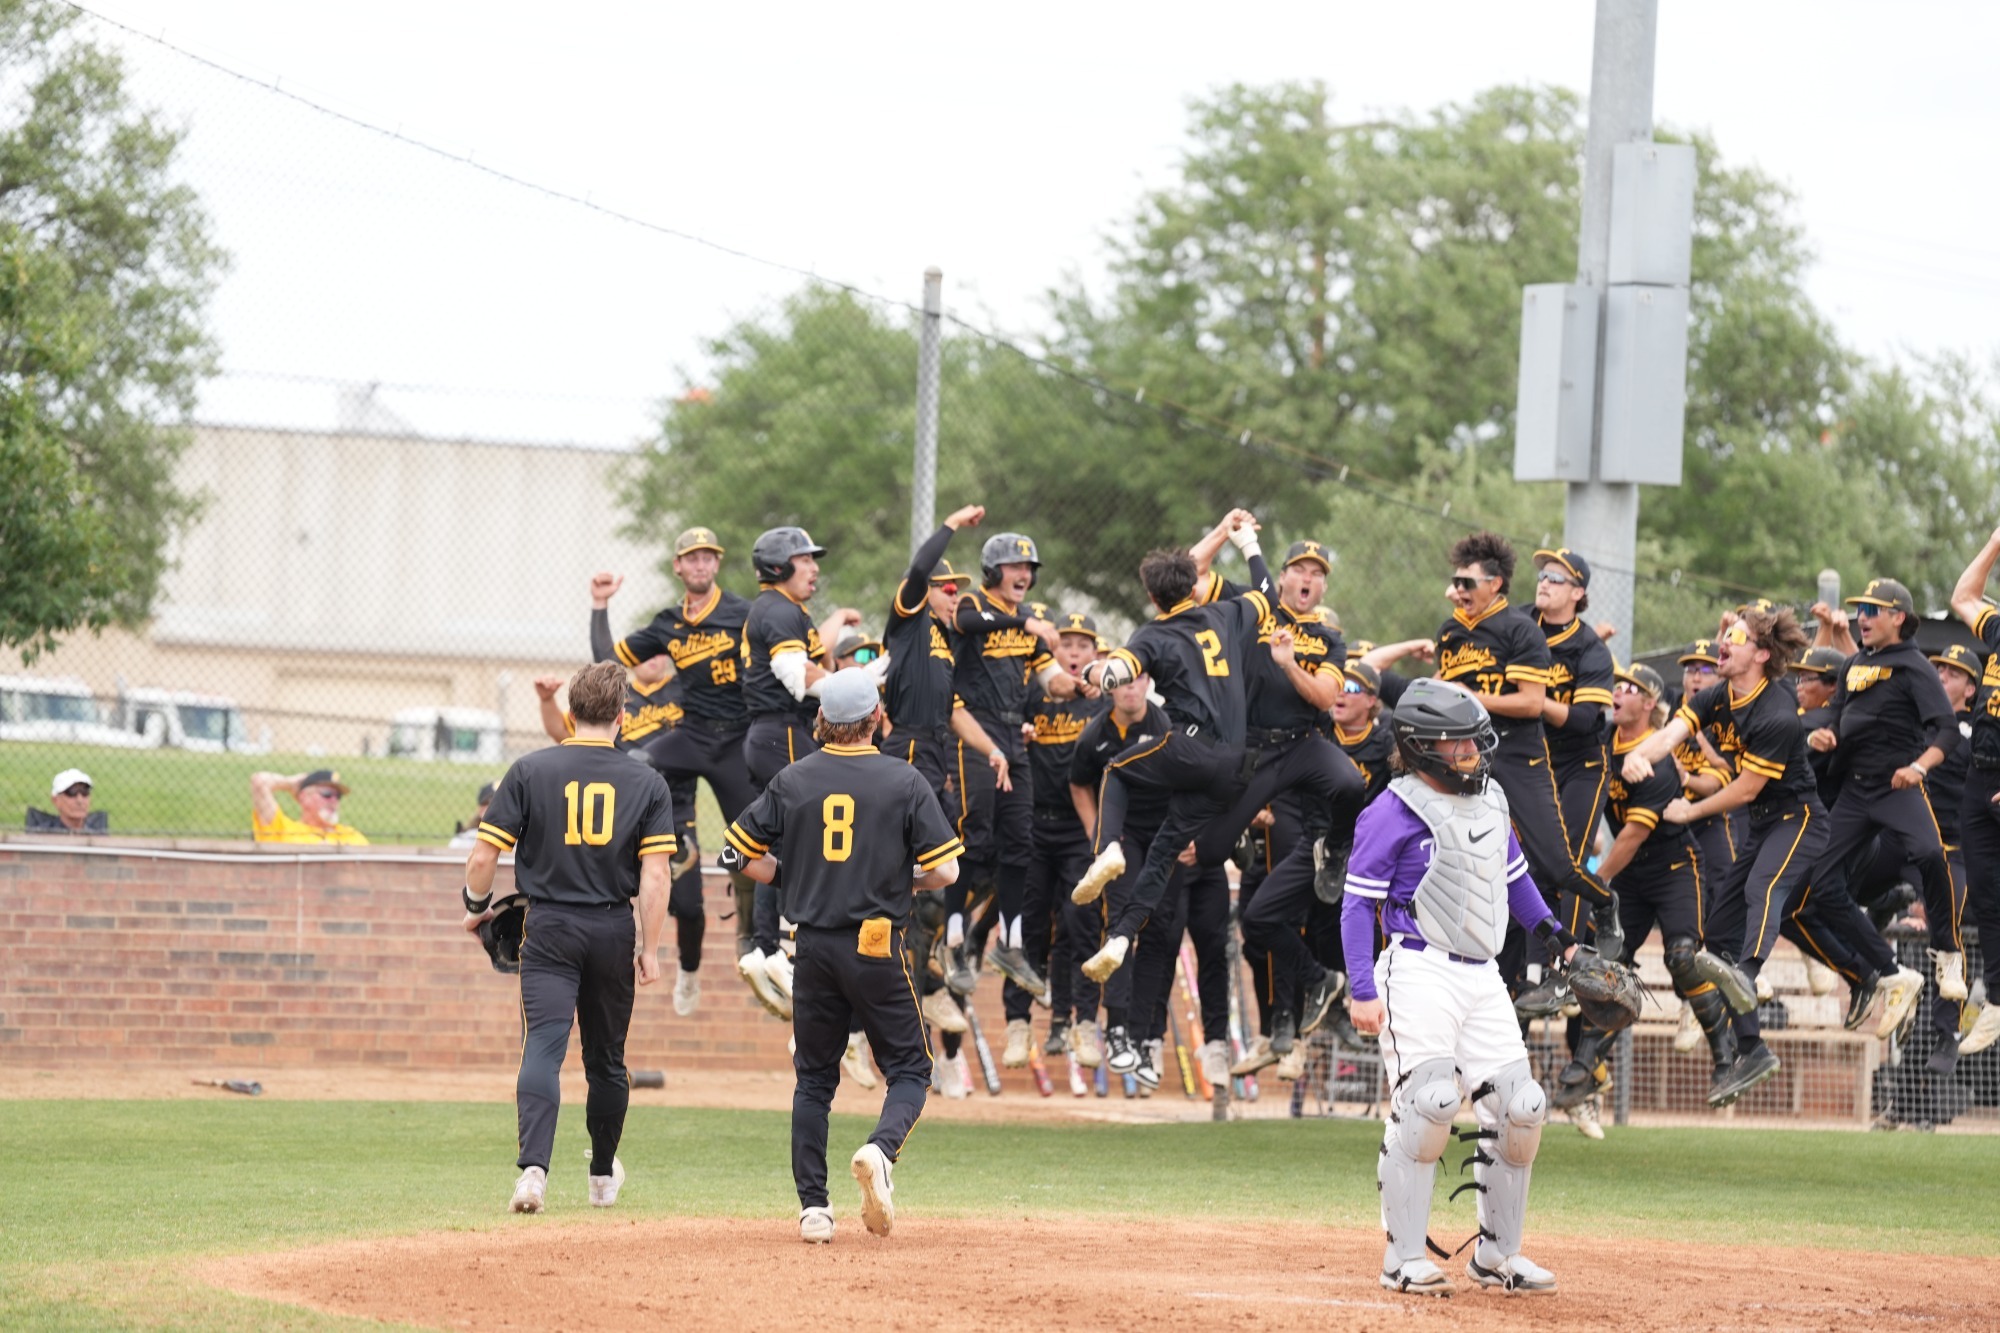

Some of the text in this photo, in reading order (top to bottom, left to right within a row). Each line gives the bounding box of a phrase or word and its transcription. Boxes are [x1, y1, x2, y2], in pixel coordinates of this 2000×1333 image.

[1017, 540, 1031, 556] T
[1304, 541, 1320, 556] T
[1864, 580, 1879, 595] T
[1031, 603, 1047, 618] T
[1068, 614, 1085, 629] T
[983, 627, 1038, 653] Bulldog
[1695, 639, 1711, 655] T
[1195, 629, 1230, 677] 2
[1948, 644, 1965, 660] T
[710, 658, 737, 685] 29
[1476, 673, 1504, 697] 37
[1033, 712, 1092, 739] Bulldog
[564, 781, 616, 846] 10
[823, 794, 855, 862] 8
